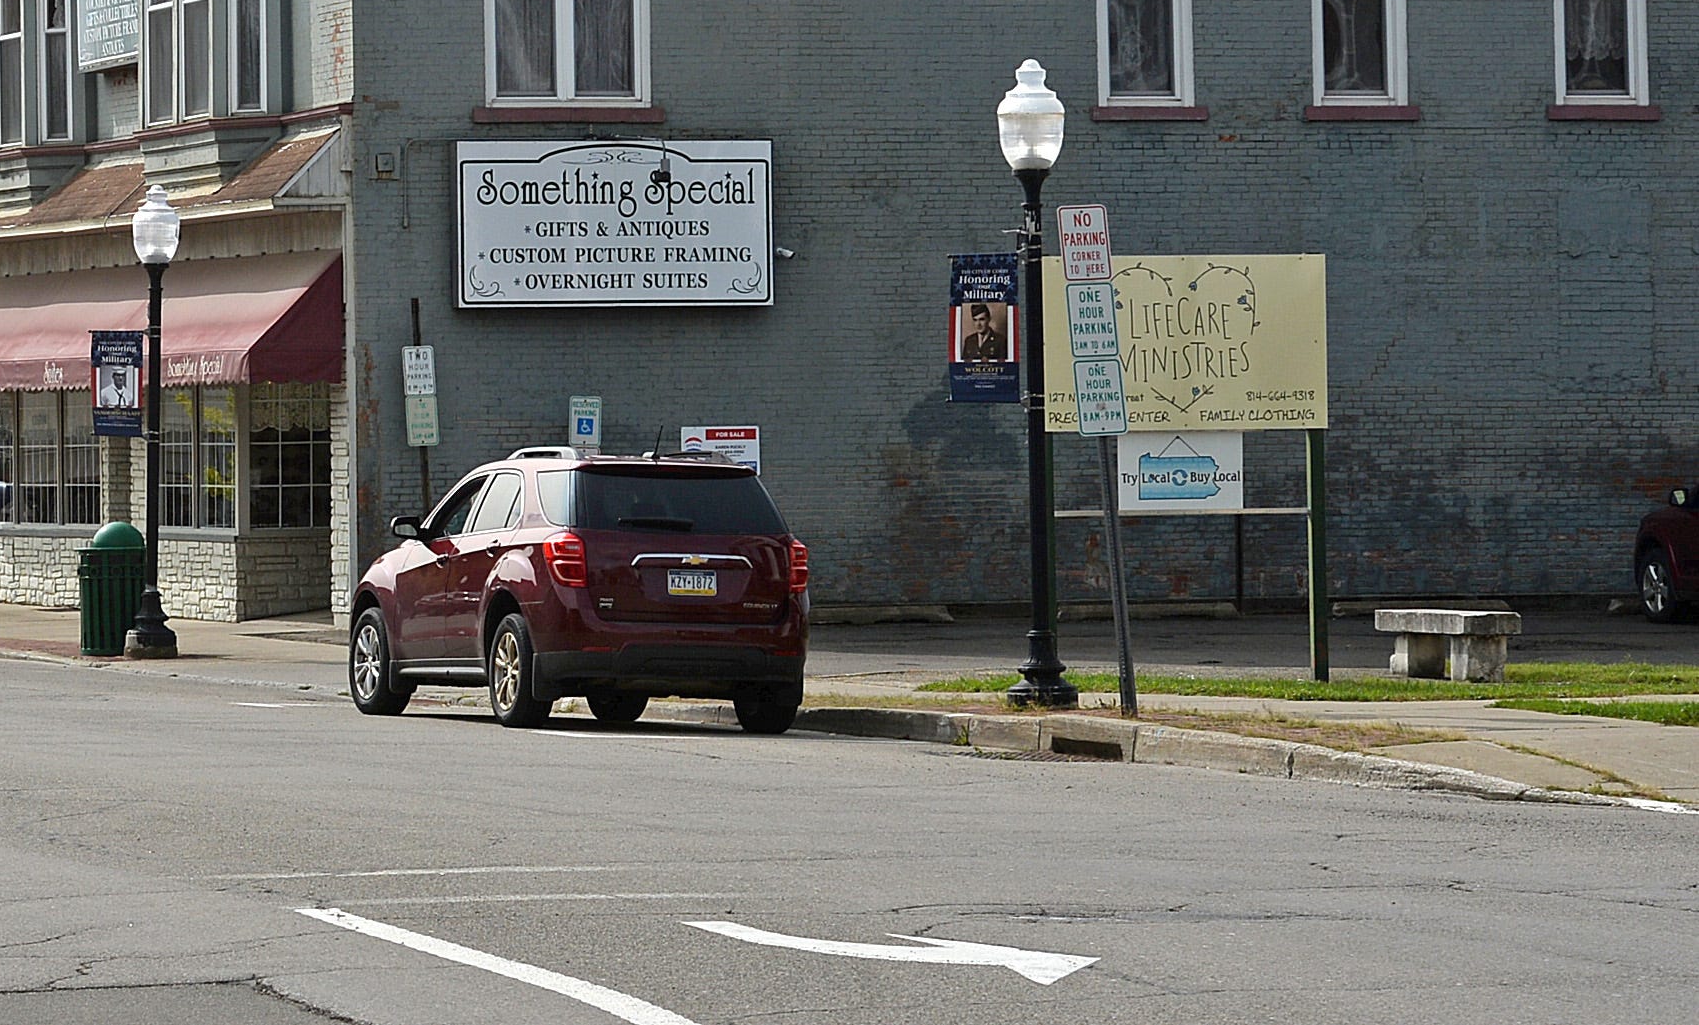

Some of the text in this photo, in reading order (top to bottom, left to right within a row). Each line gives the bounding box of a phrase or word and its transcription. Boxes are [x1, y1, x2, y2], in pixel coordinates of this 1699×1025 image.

[476, 167, 756, 218] Something Special
[1072, 212, 1092, 228] NO
[535, 220, 710, 240] GIFTS & ANTIQUES
[1063, 231, 1106, 247] PARKING
[489, 246, 753, 264] CUSTOM PICTURE FRAMING
[1071, 251, 1101, 262] CORNER
[1069, 263, 1105, 275] TO HERE
[524, 272, 709, 290] OVERNIGHT SUITES
[959, 274, 1011, 286] Honoring
[963, 289, 1006, 301] Military
[1078, 290, 1102, 303] ONE
[1078, 306, 1104, 319] HOUR
[1073, 321, 1113, 336] PARKING
[97, 344, 138, 354] Honoring
[101, 356, 133, 365] Military
[408, 351, 429, 361] TWO
[1118, 341, 1252, 383] MINISTRIES
[408, 363, 430, 371] HOUR
[1088, 366, 1107, 377] ONE
[1085, 379, 1112, 390] HOUR
[1049, 393, 1067, 403] 127
[1245, 390, 1315, 402] 814-664-9318
[1080, 391, 1120, 403] PARKING
[573, 409, 597, 417] PARKING
[1128, 409, 1316, 424] ENTER FAMILY CLOTHING
[1121, 470, 1241, 486] Try Local Buy Local
